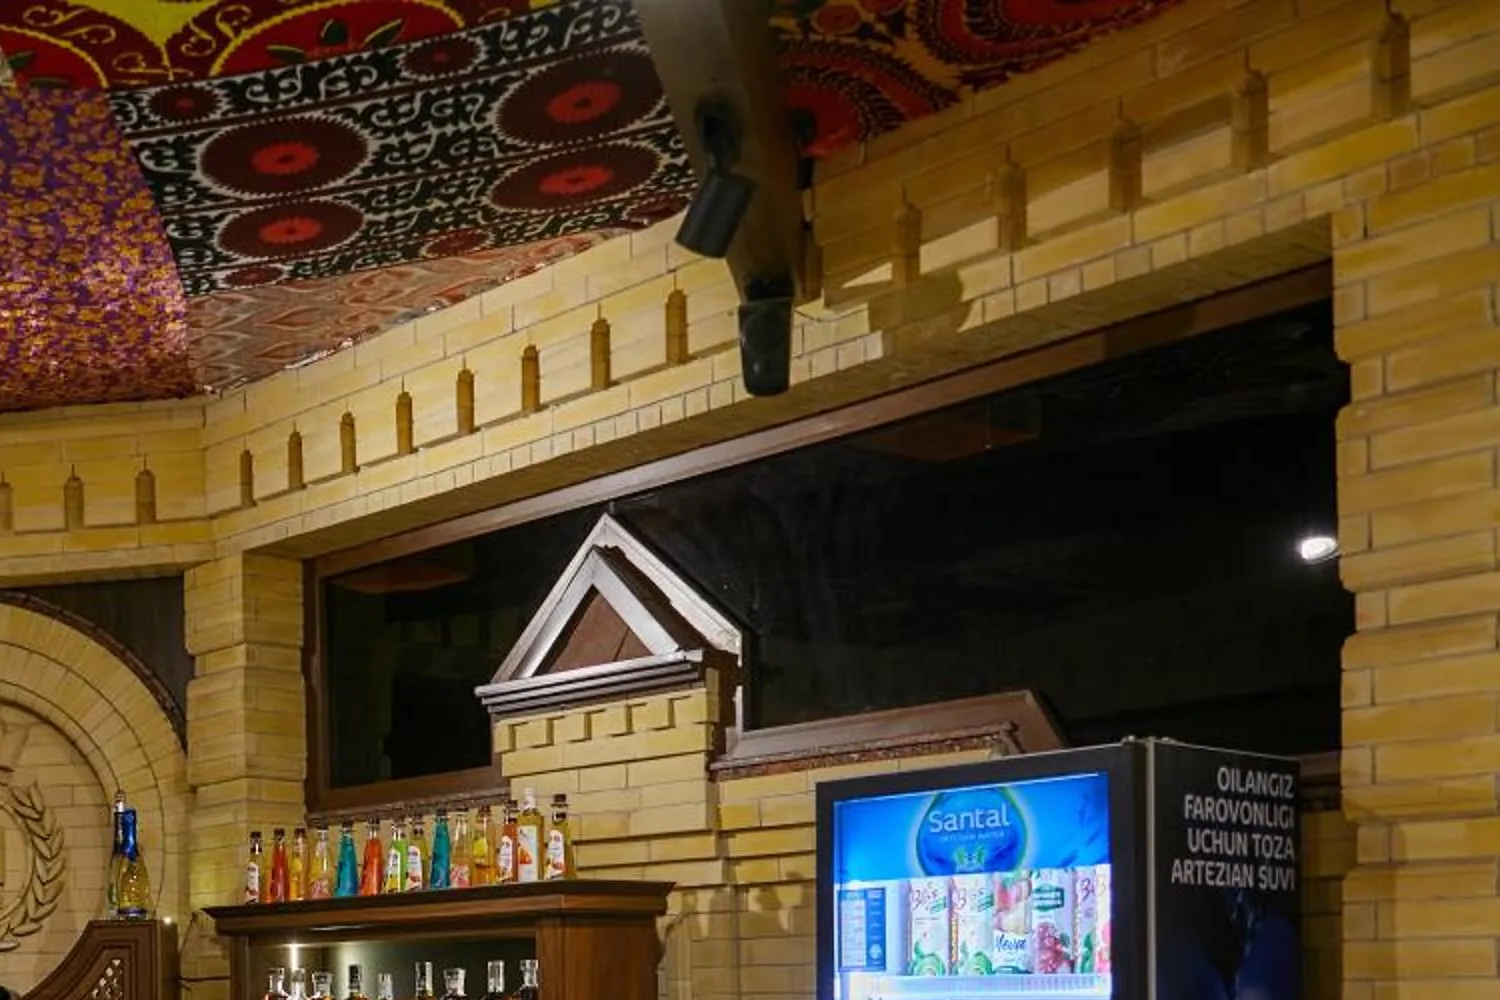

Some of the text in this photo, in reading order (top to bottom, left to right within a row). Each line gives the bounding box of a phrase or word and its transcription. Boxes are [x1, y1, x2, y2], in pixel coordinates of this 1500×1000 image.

[1217, 766, 1295, 799] OILANGIZ
[928, 803, 1012, 834] Santal
[1184, 794, 1295, 829] FAROVONLIGI
[1187, 828, 1296, 861] UCHUN TOZA
[1171, 858, 1296, 892] ARTEZIAN SUVI
